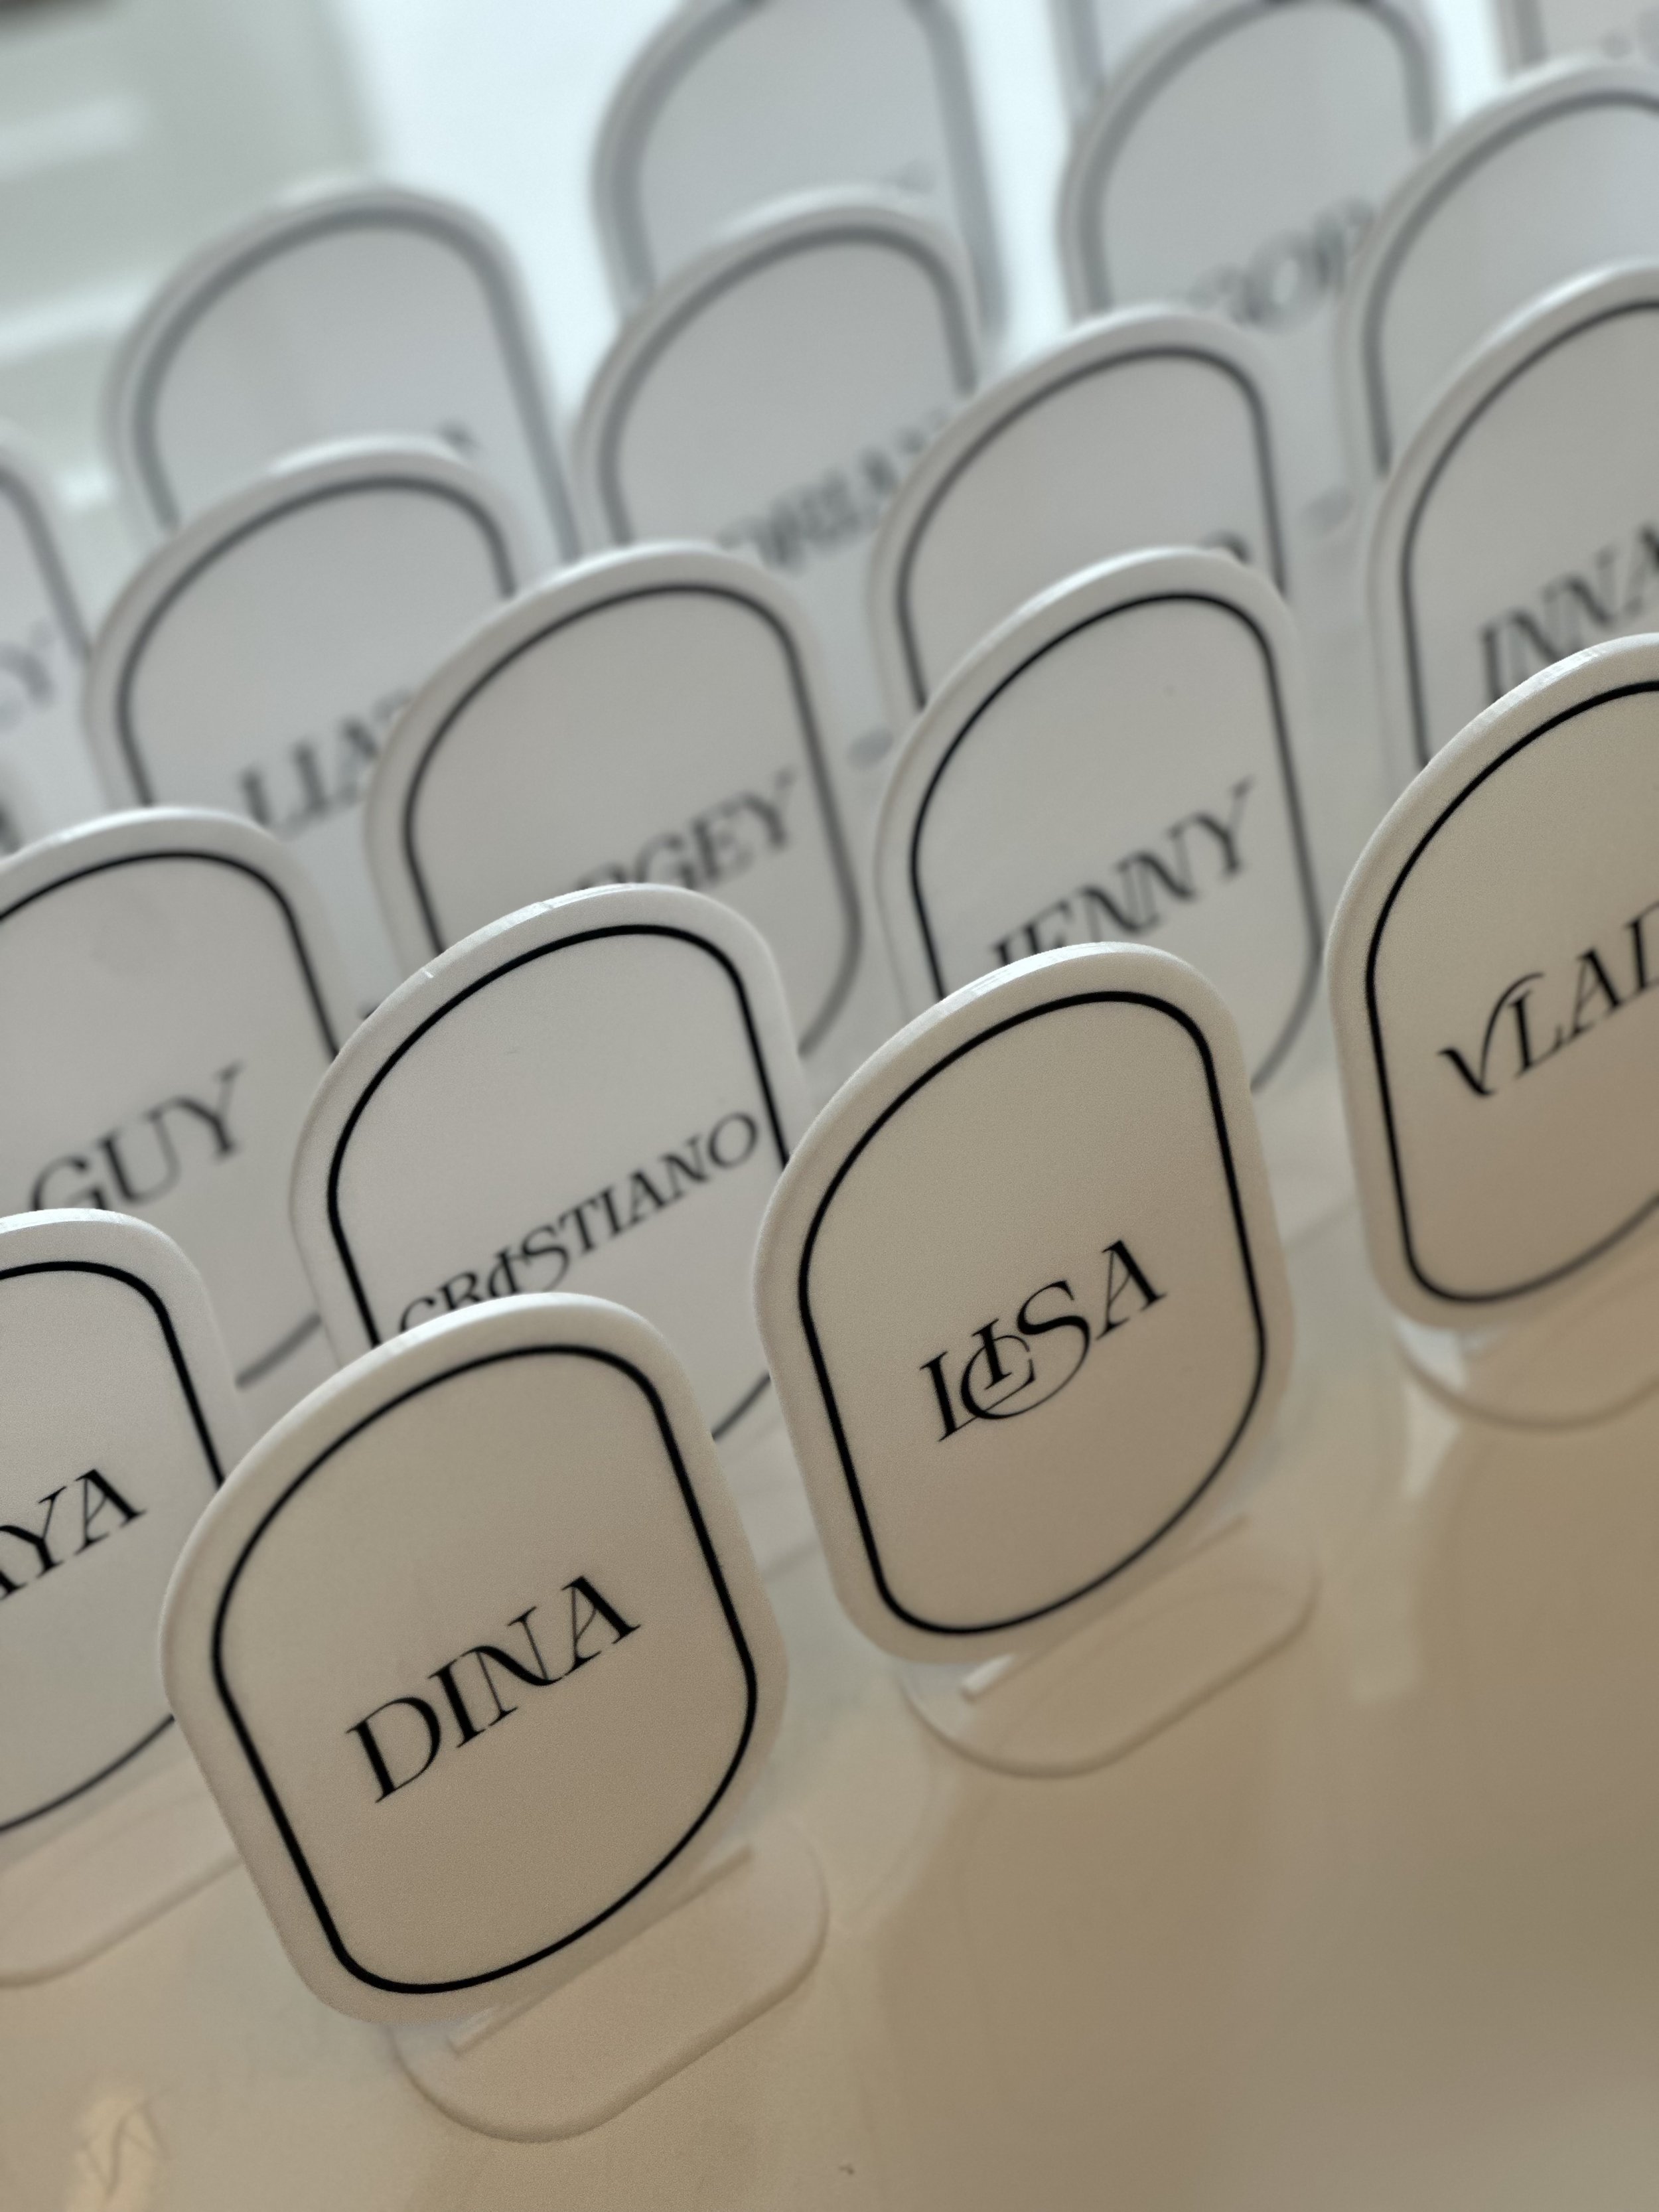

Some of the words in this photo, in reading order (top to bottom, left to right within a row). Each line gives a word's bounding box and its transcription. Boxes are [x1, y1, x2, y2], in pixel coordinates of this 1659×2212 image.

[573, 763, 797, 891] GEY
[29, 1059, 243, 1211] GUY
[918, 1239, 1168, 1443] LISA
[0, 1469, 147, 1601] YA
[344, 1575, 642, 1804] DINA
